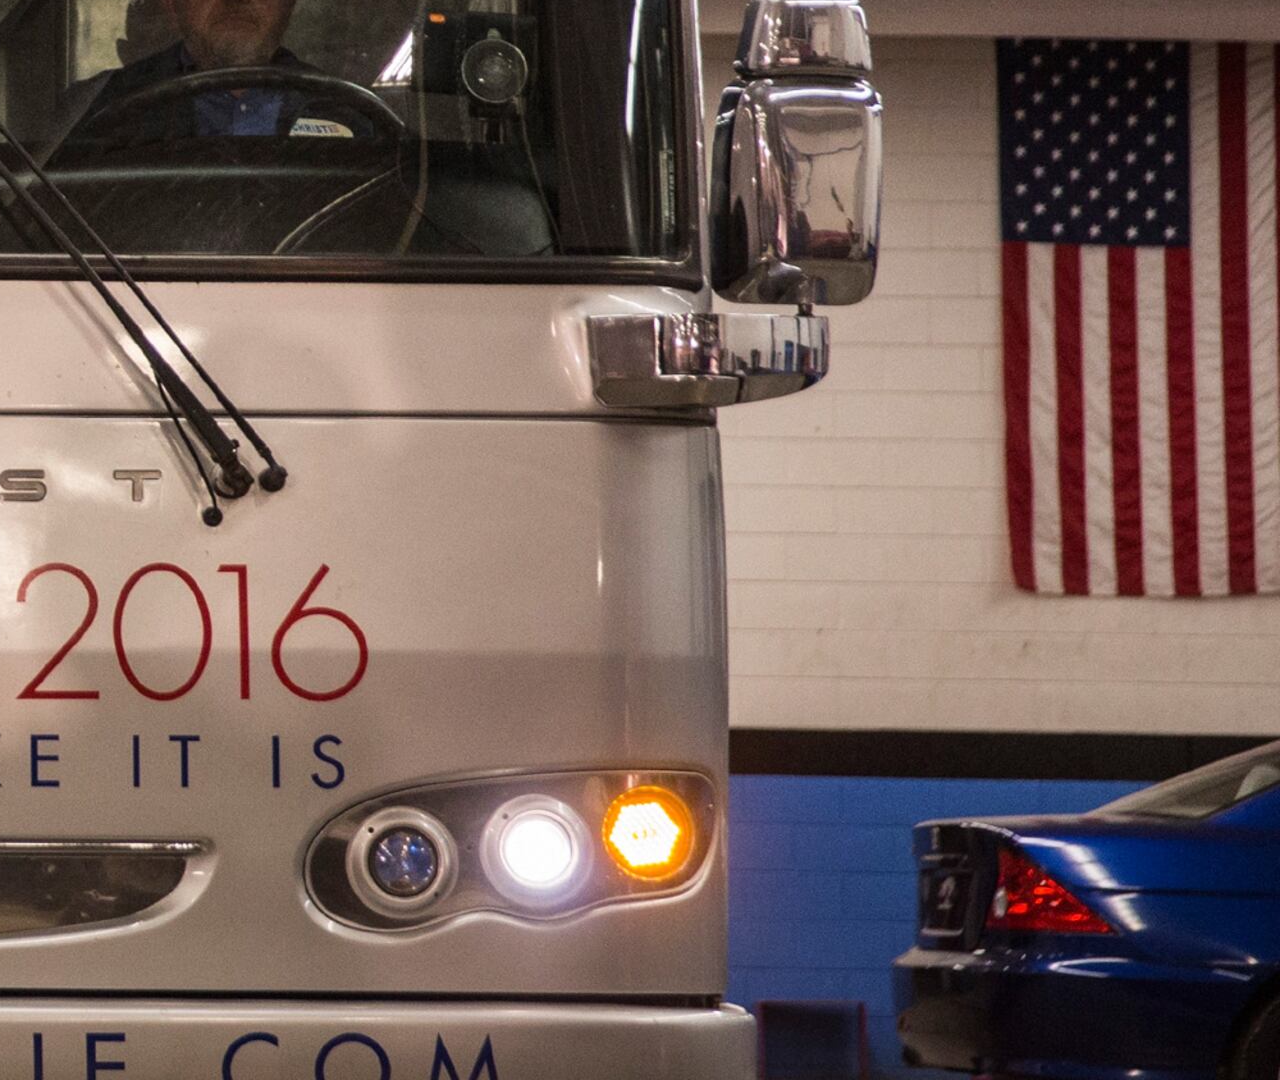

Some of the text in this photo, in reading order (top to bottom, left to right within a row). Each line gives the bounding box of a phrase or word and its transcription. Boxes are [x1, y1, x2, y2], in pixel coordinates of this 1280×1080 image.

[16, 561, 369, 702] 2016
[132, 734, 201, 788] IT
[272, 734, 346, 789] IS
